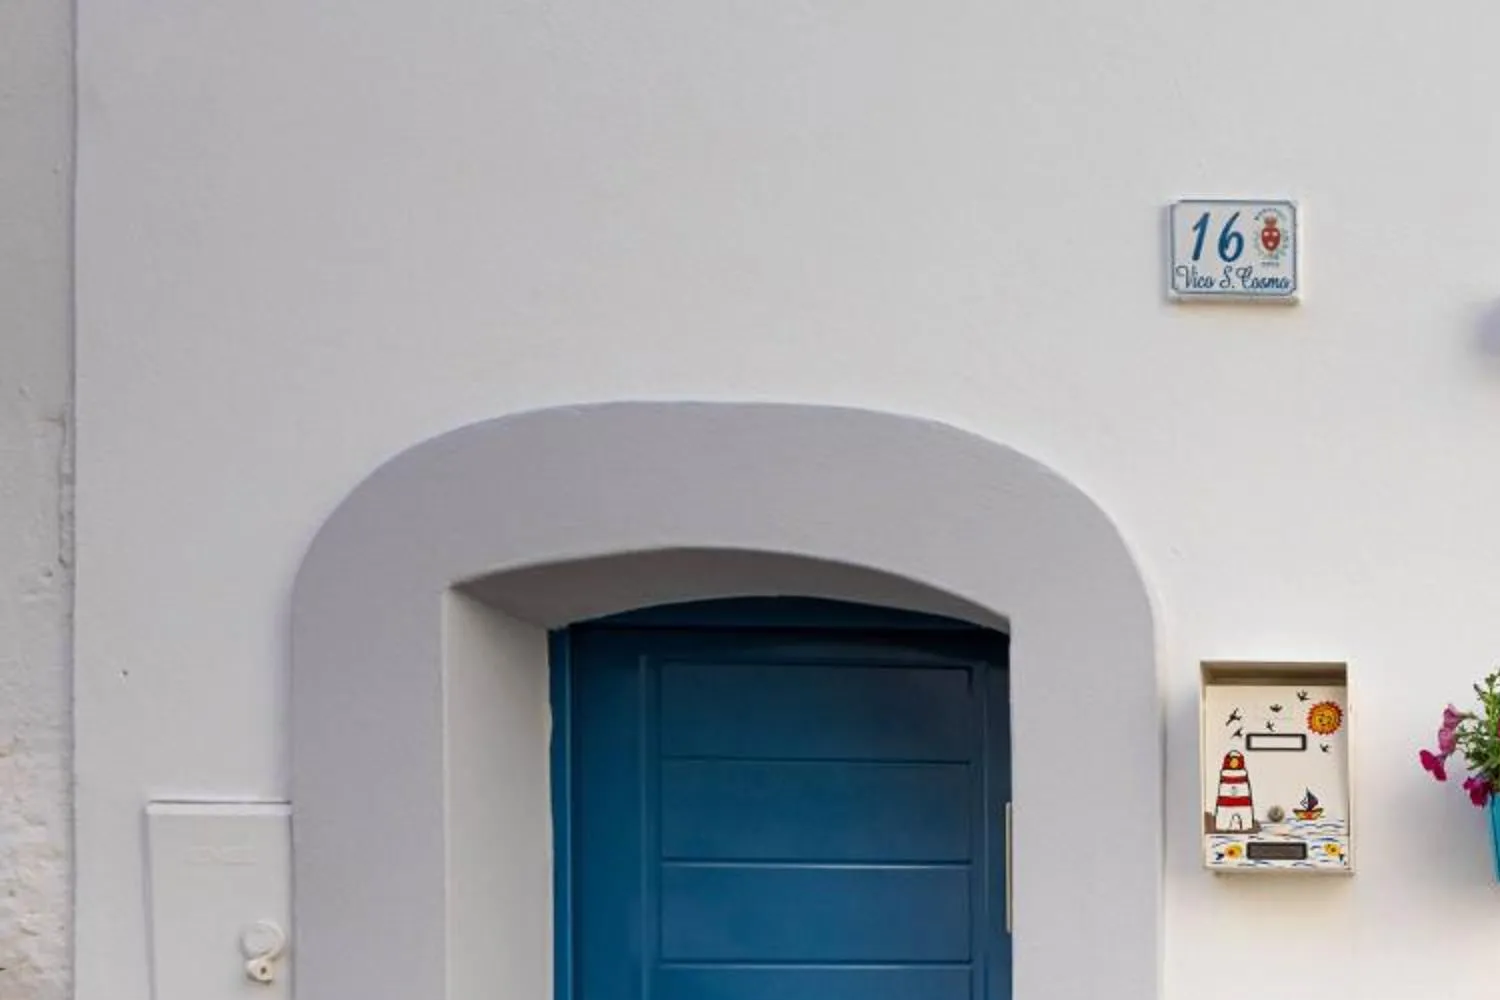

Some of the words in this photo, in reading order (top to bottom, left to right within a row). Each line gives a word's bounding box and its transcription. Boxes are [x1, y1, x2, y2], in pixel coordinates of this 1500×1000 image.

[1192, 211, 1245, 262] 16
[1175, 265, 1215, 288] Vico
[1219, 265, 1236, 289] S.
